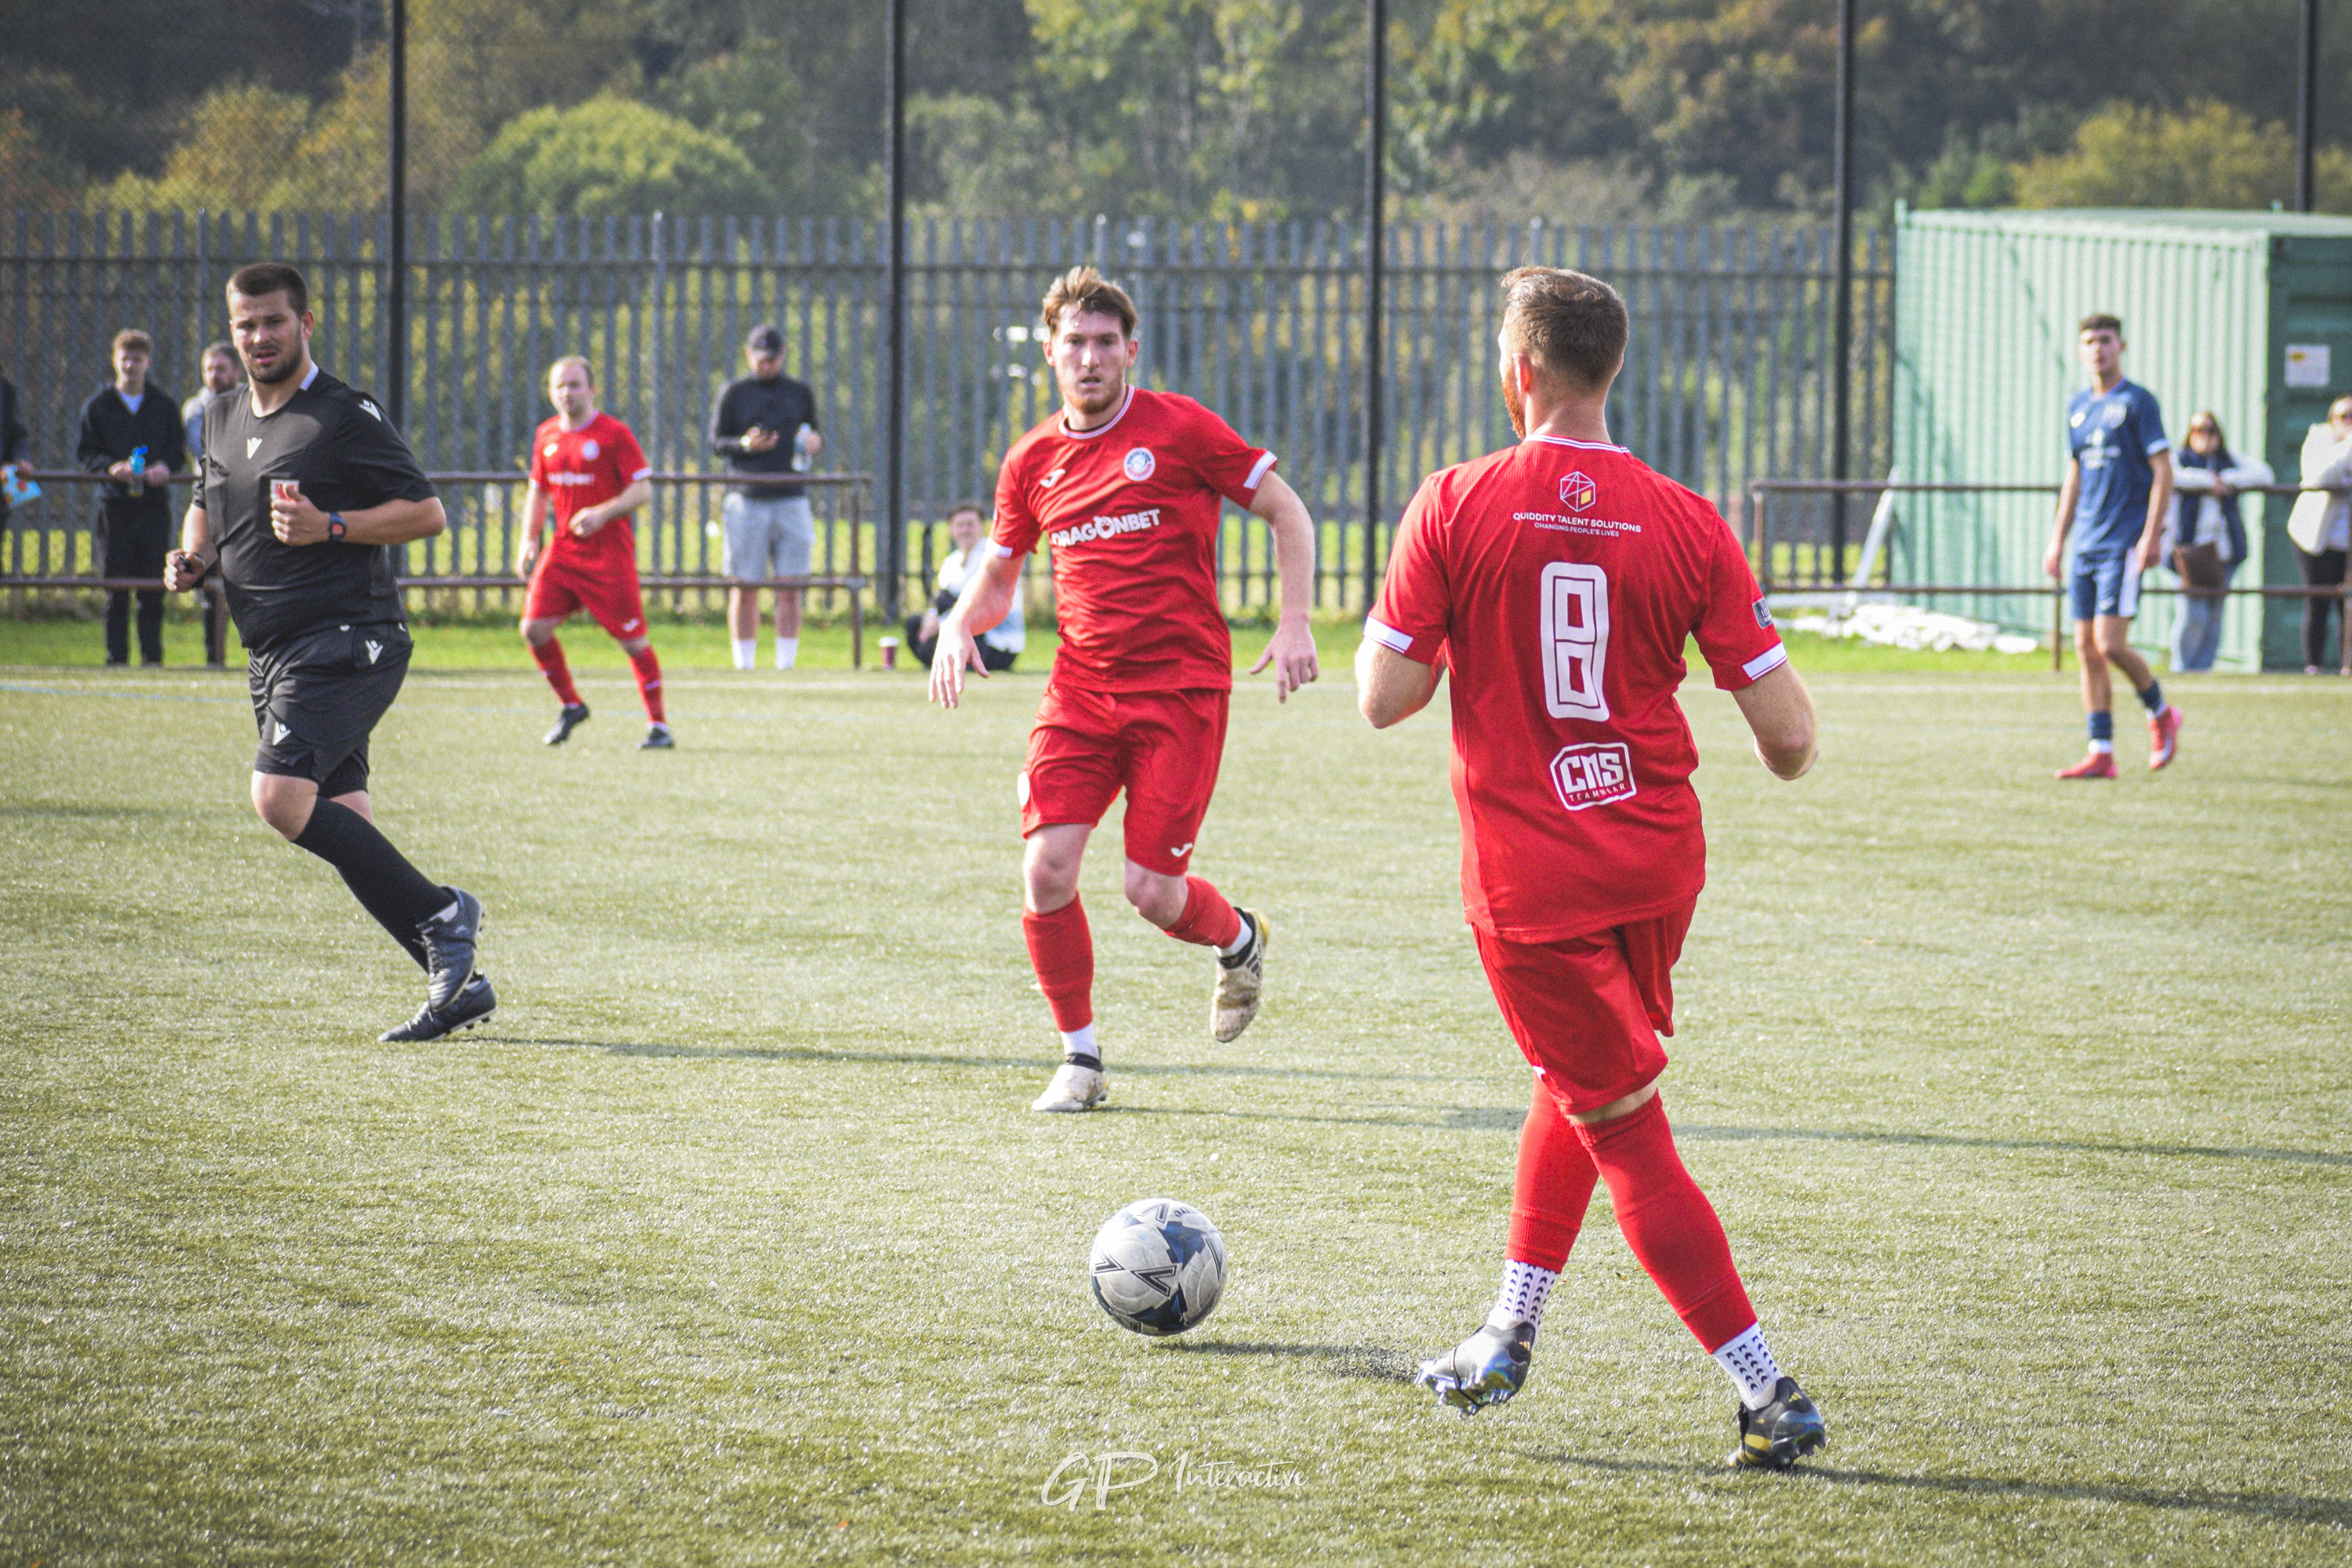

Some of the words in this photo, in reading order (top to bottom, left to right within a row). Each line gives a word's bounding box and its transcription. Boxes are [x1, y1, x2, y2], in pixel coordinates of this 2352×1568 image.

[1051, 508, 1160, 547] DRAGONBET
[1513, 512, 1555, 522] QUIDDITY
[1557, 514, 1589, 526] TALENT
[1591, 519, 1642, 533] SOLUTIONS
[1534, 522, 1569, 532] CHANGING
[1570, 526, 1600, 535] PEOPLE'S
[1541, 561, 1610, 722] 8
[1559, 752, 1624, 794] CMS
[1569, 782, 1626, 803] TEAMWEAR
